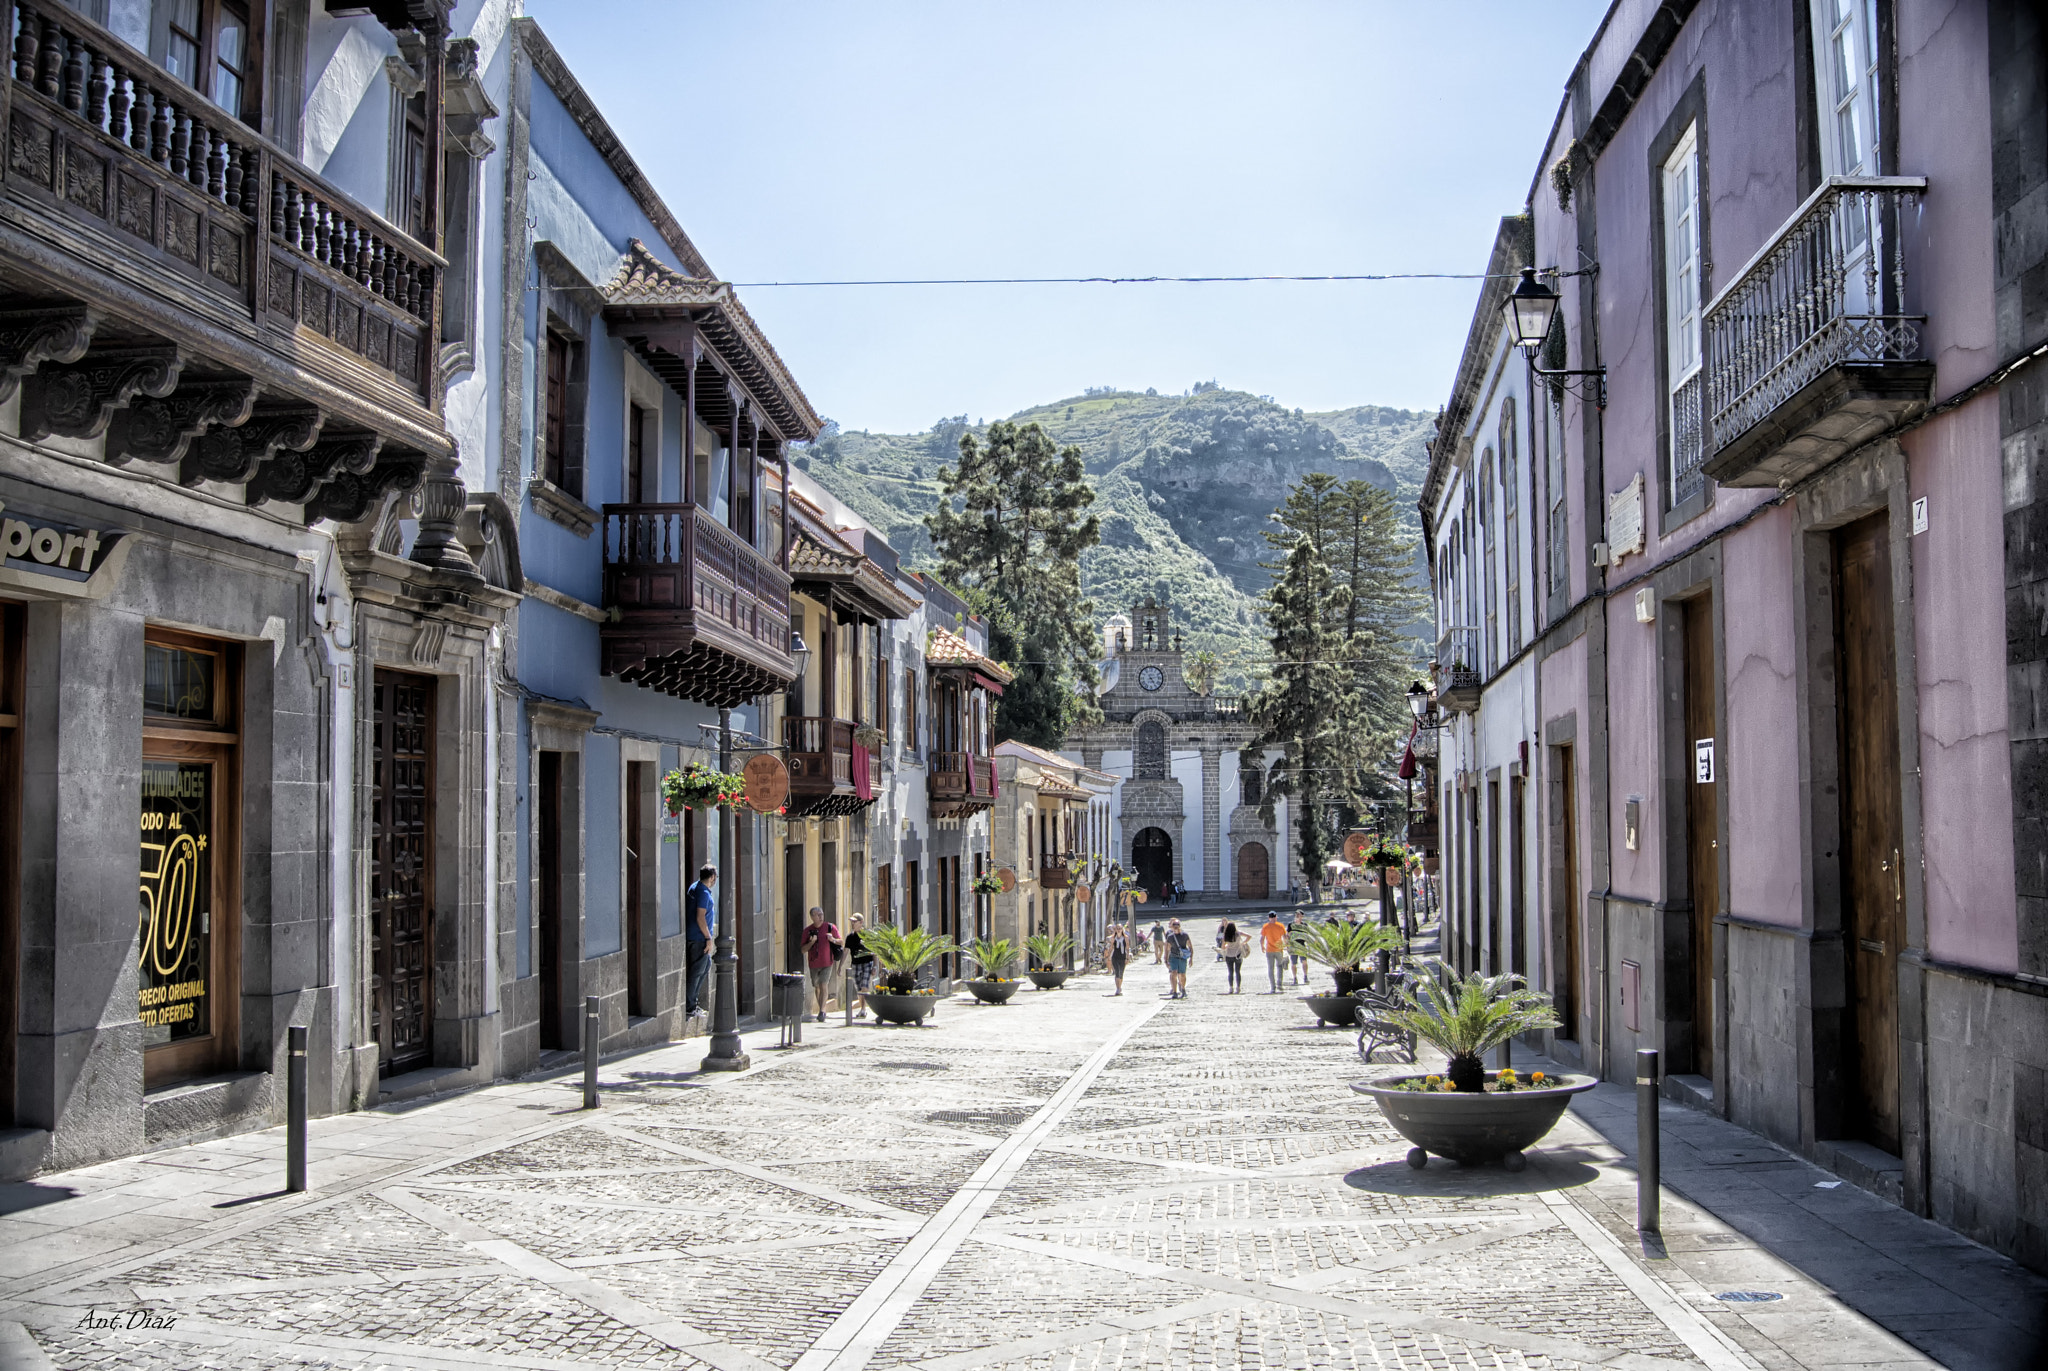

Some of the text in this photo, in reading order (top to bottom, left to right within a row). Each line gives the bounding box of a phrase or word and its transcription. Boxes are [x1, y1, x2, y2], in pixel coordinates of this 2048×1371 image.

[1916, 500, 1924, 519] 7
[0, 501, 100, 572] port
[142, 769, 204, 797] TUNIDADES
[141, 812, 182, 831] ODO AL
[168, 980, 205, 1002] ORIGINAL
[138, 1001, 194, 1028] PTO OFERTAS
